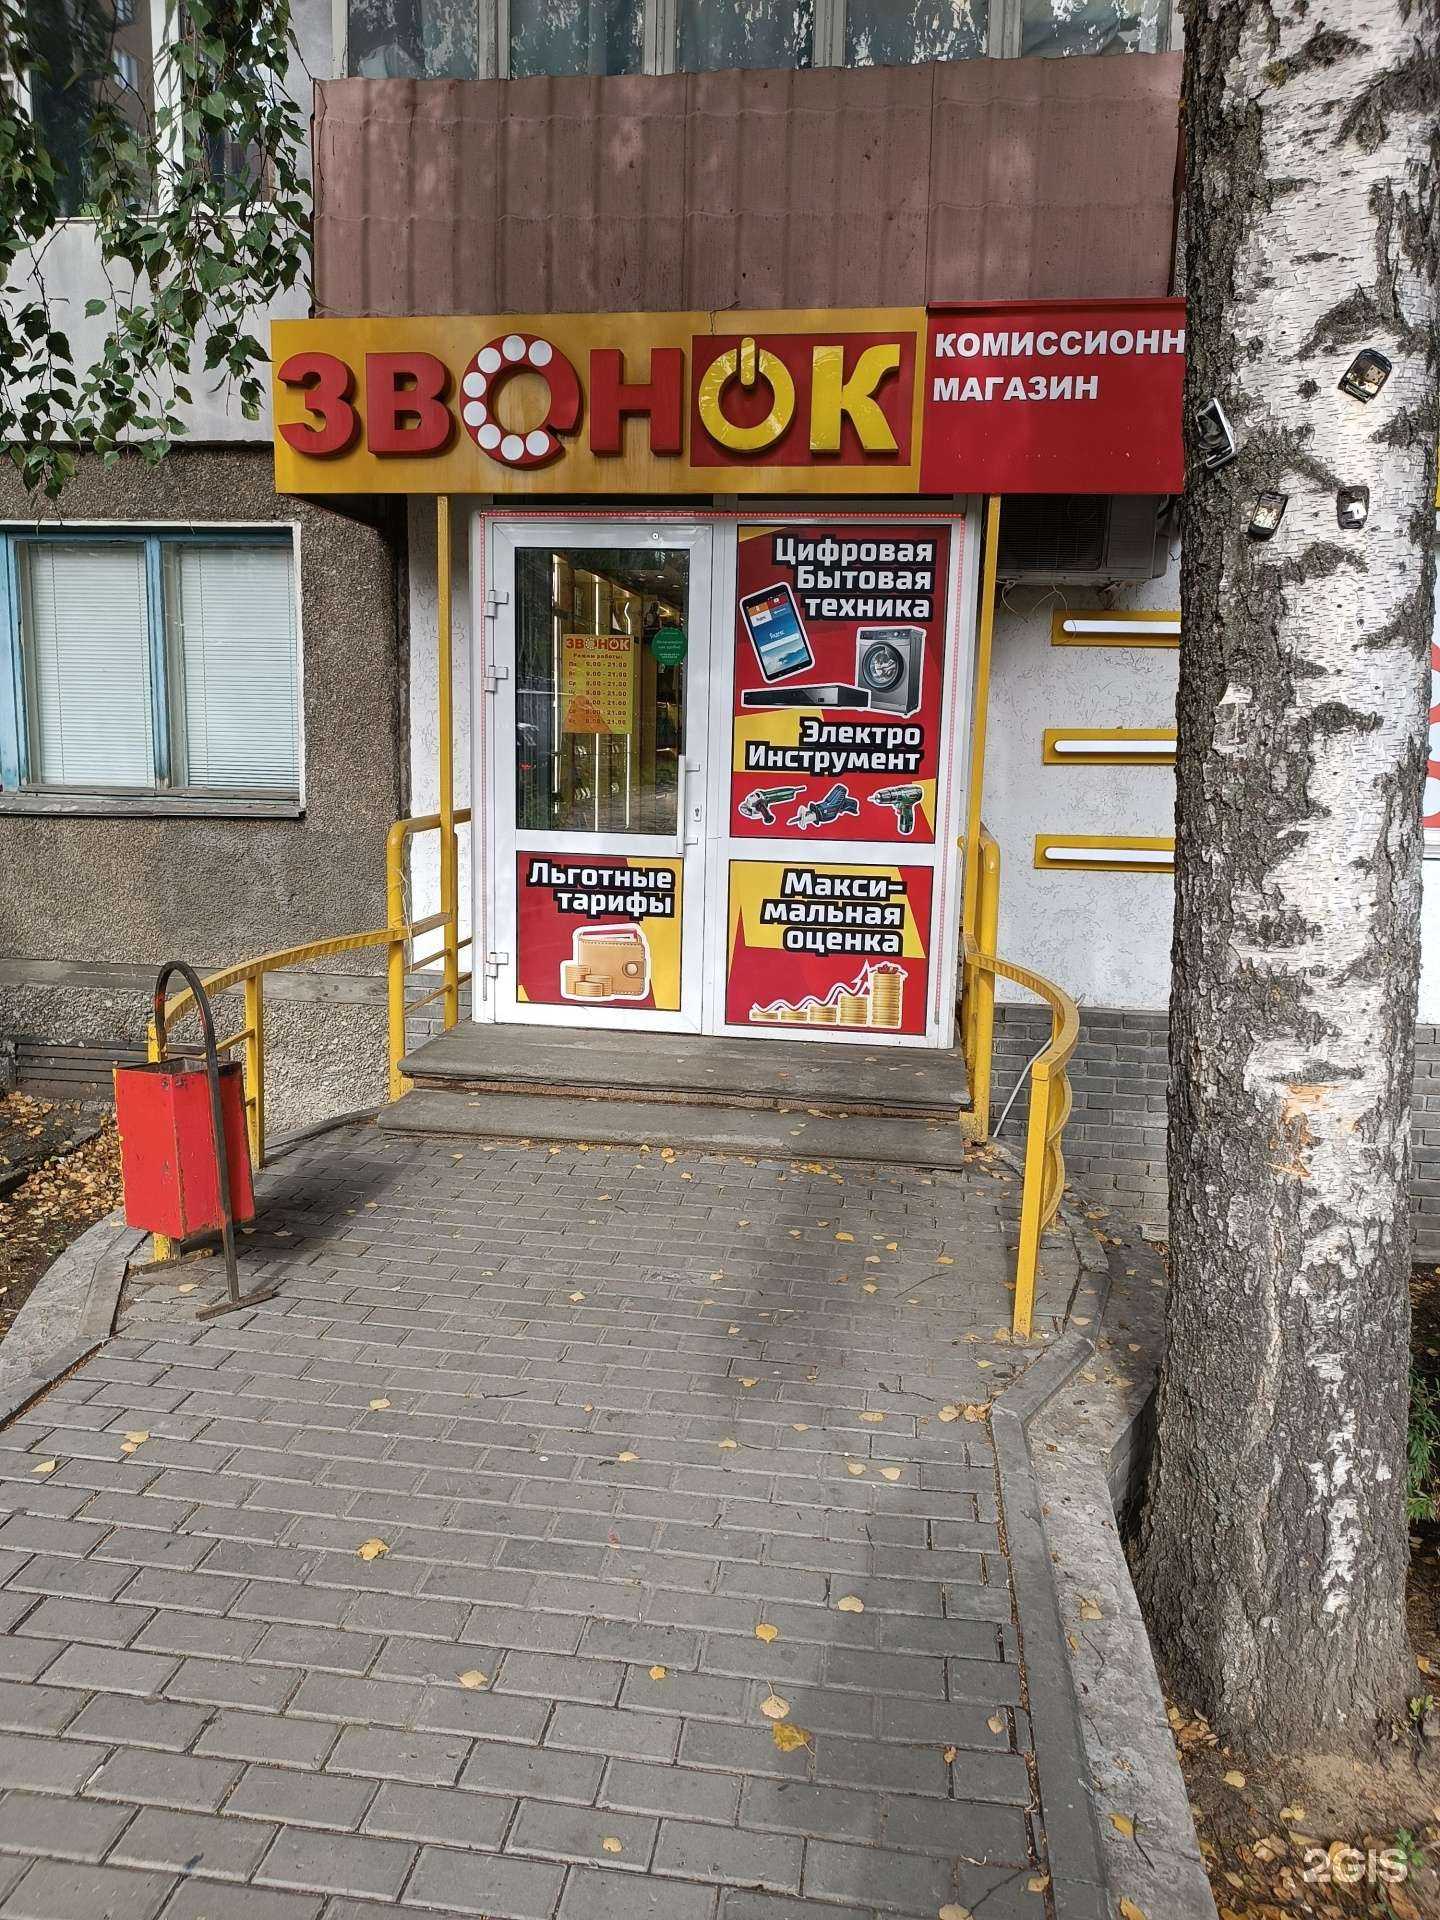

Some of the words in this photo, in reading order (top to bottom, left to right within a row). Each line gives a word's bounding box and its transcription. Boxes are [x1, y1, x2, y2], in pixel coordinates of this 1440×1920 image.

[935, 329, 1186, 357] КОМИССИОНН
[277, 333, 901, 469] ЗВОНОК
[933, 375, 1099, 401] МАГАЗИН
[775, 538, 933, 566] Цифровая
[797, 565, 932, 590] Бытовая
[805, 598, 930, 618] техника
[803, 721, 921, 749] Электро
[749, 745, 920, 773] Инструмент
[529, 862, 672, 888] Льготные
[784, 872, 903, 898] Макси-
[557, 891, 671, 916] тарифы
[764, 903, 901, 925] мальная
[786, 930, 899, 953] оценка
